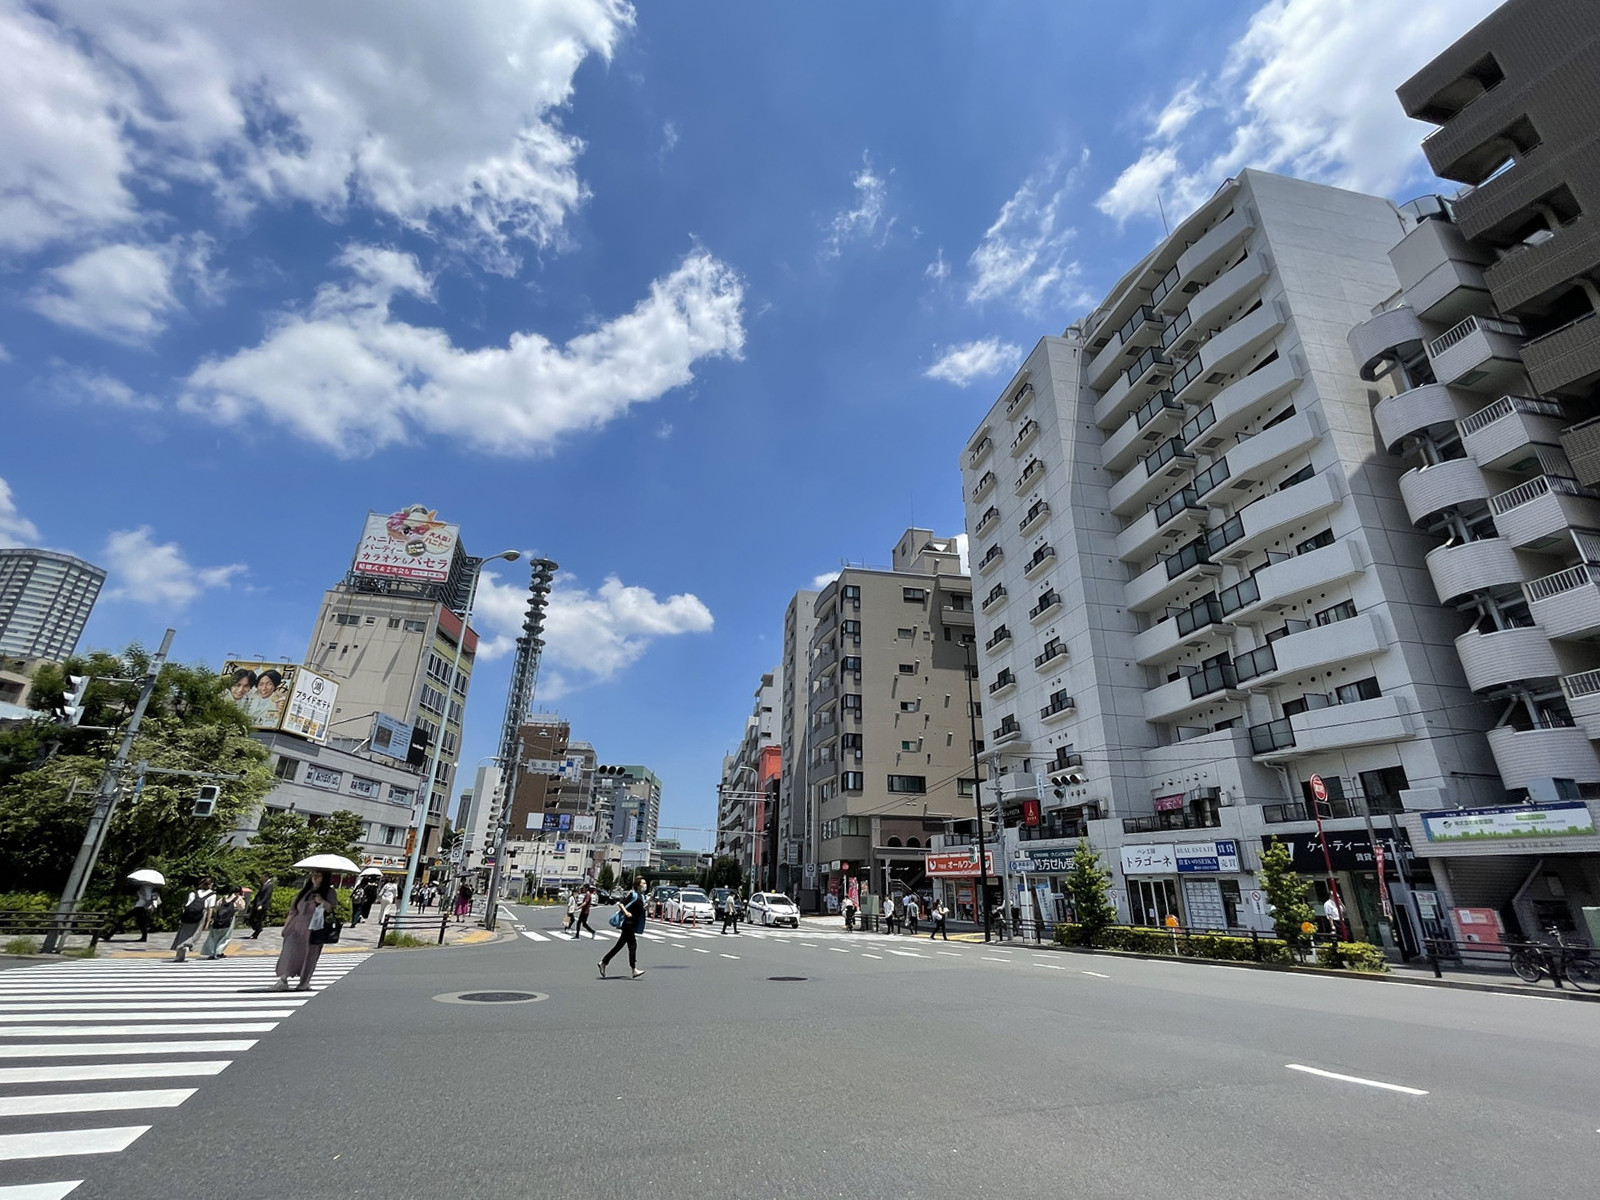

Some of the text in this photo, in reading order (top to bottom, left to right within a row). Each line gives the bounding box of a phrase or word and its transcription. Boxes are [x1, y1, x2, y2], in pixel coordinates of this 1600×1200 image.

[366, 535, 405, 545] ハニトー
[363, 544, 404, 555] パーティー
